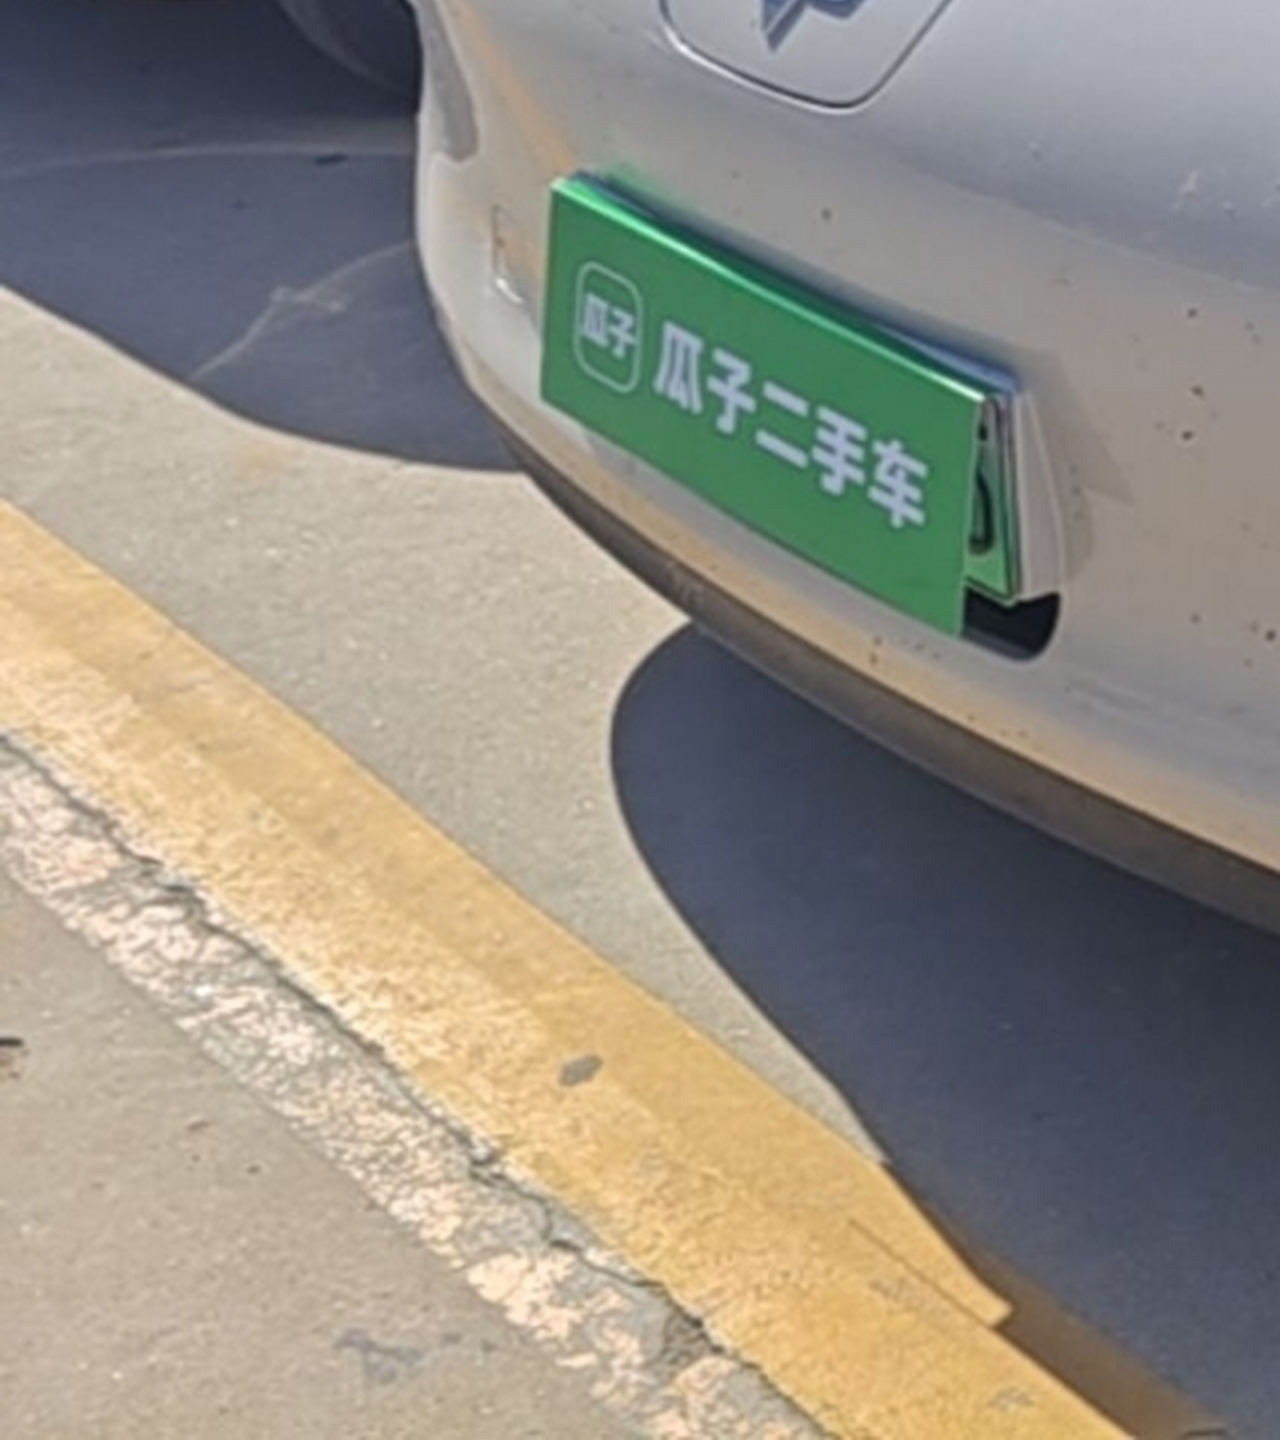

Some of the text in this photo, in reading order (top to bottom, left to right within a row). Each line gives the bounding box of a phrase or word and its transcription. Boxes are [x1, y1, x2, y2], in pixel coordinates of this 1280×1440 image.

[579, 293, 637, 359] 瓜子
[654, 321, 928, 529] 瓜子二手车
